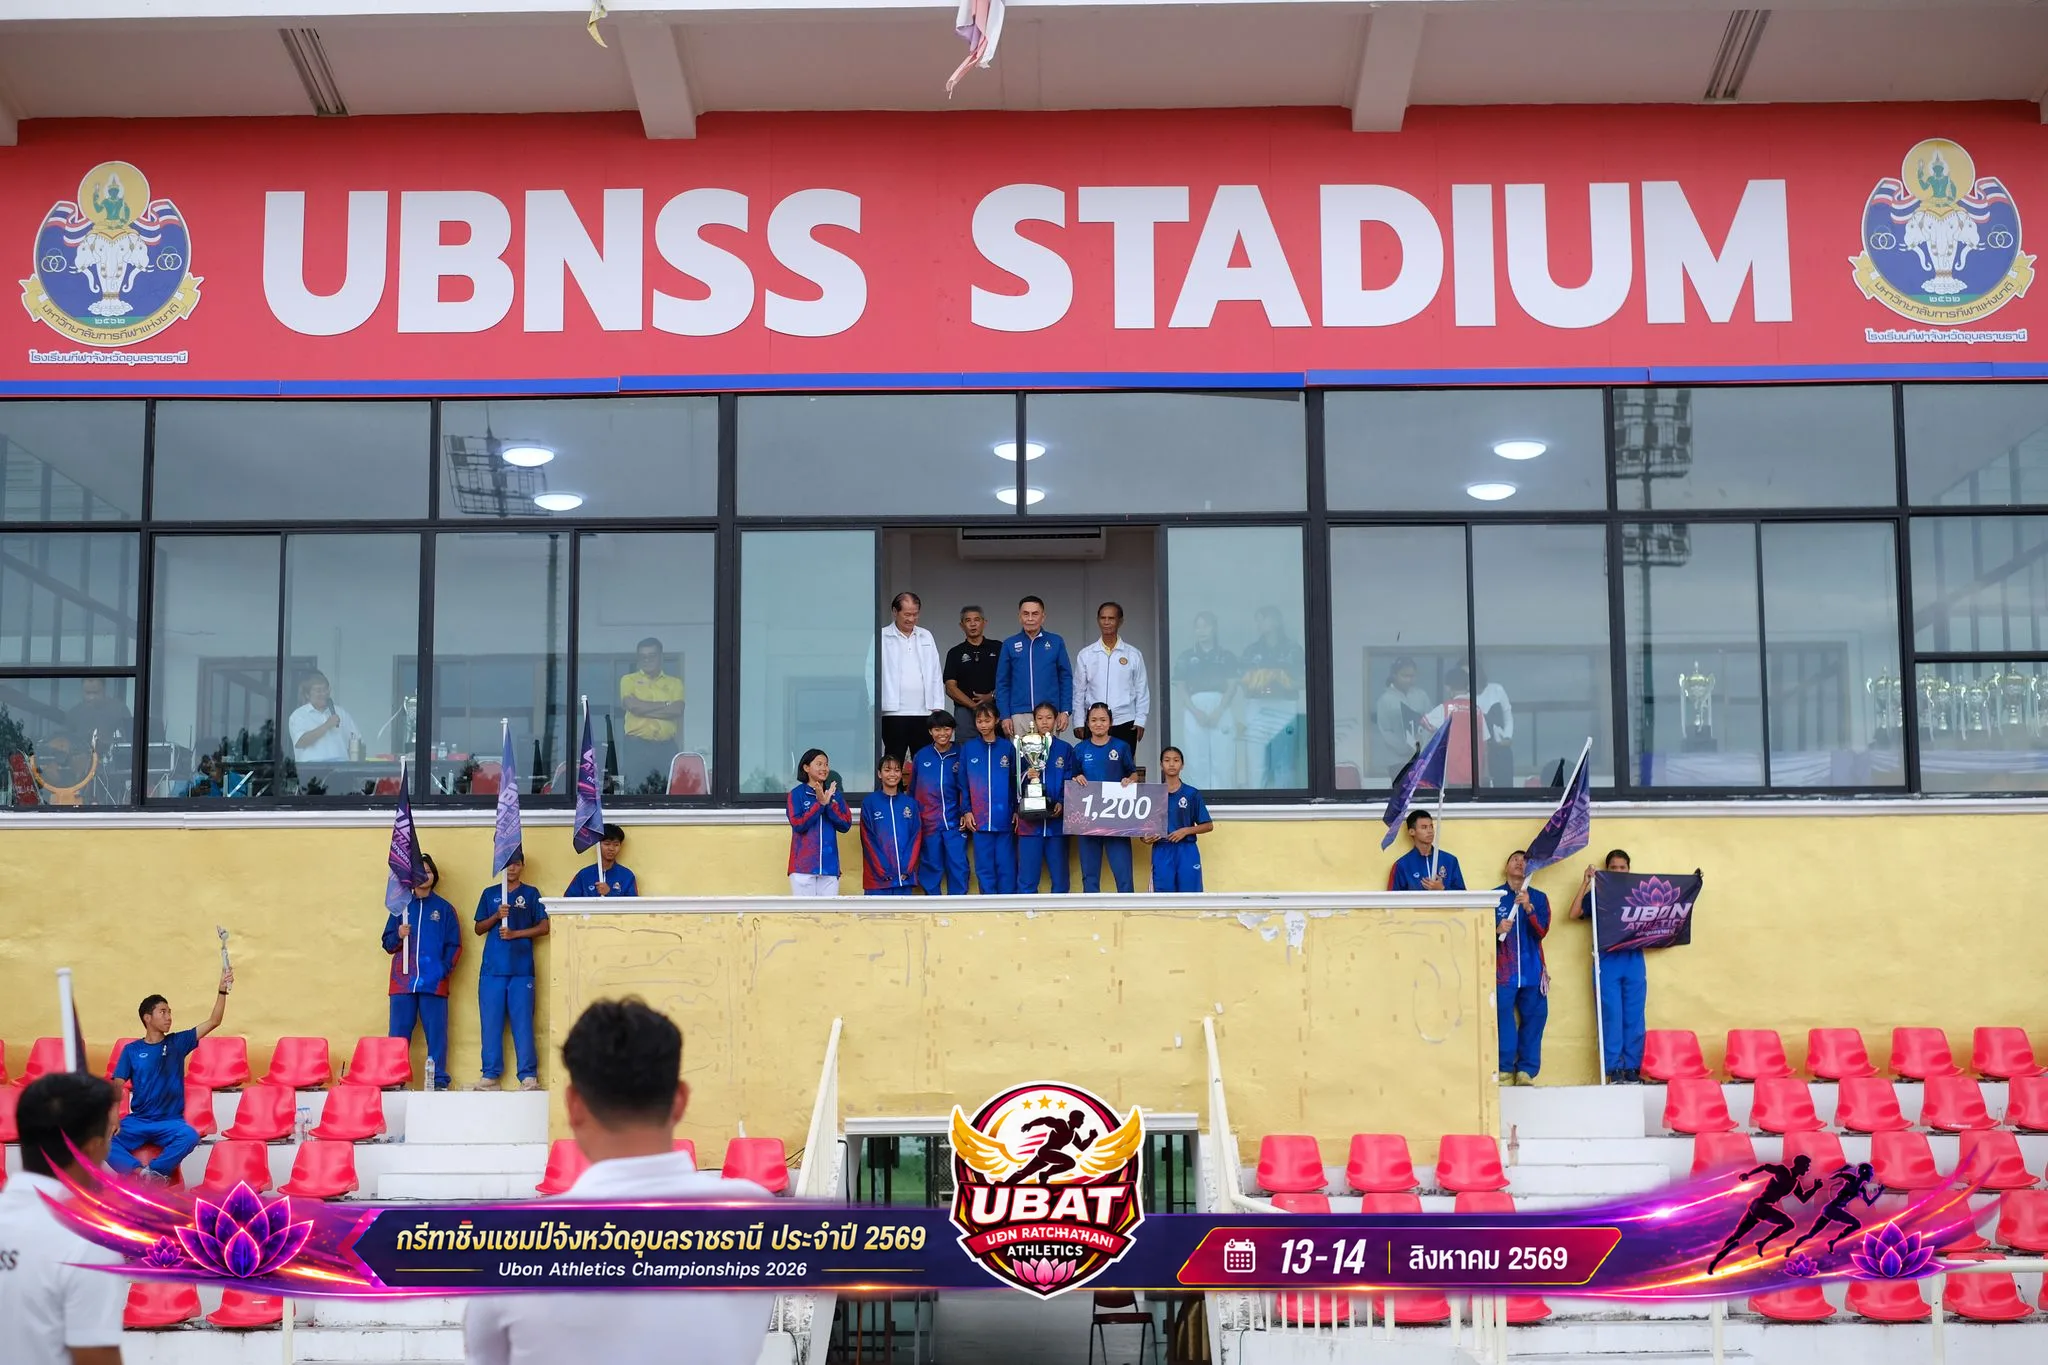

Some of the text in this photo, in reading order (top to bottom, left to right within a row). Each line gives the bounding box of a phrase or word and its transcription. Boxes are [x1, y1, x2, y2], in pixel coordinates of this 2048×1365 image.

[263, 179, 1792, 337] UBNSS STADIUM
[1081, 794, 1152, 821] 1,200
